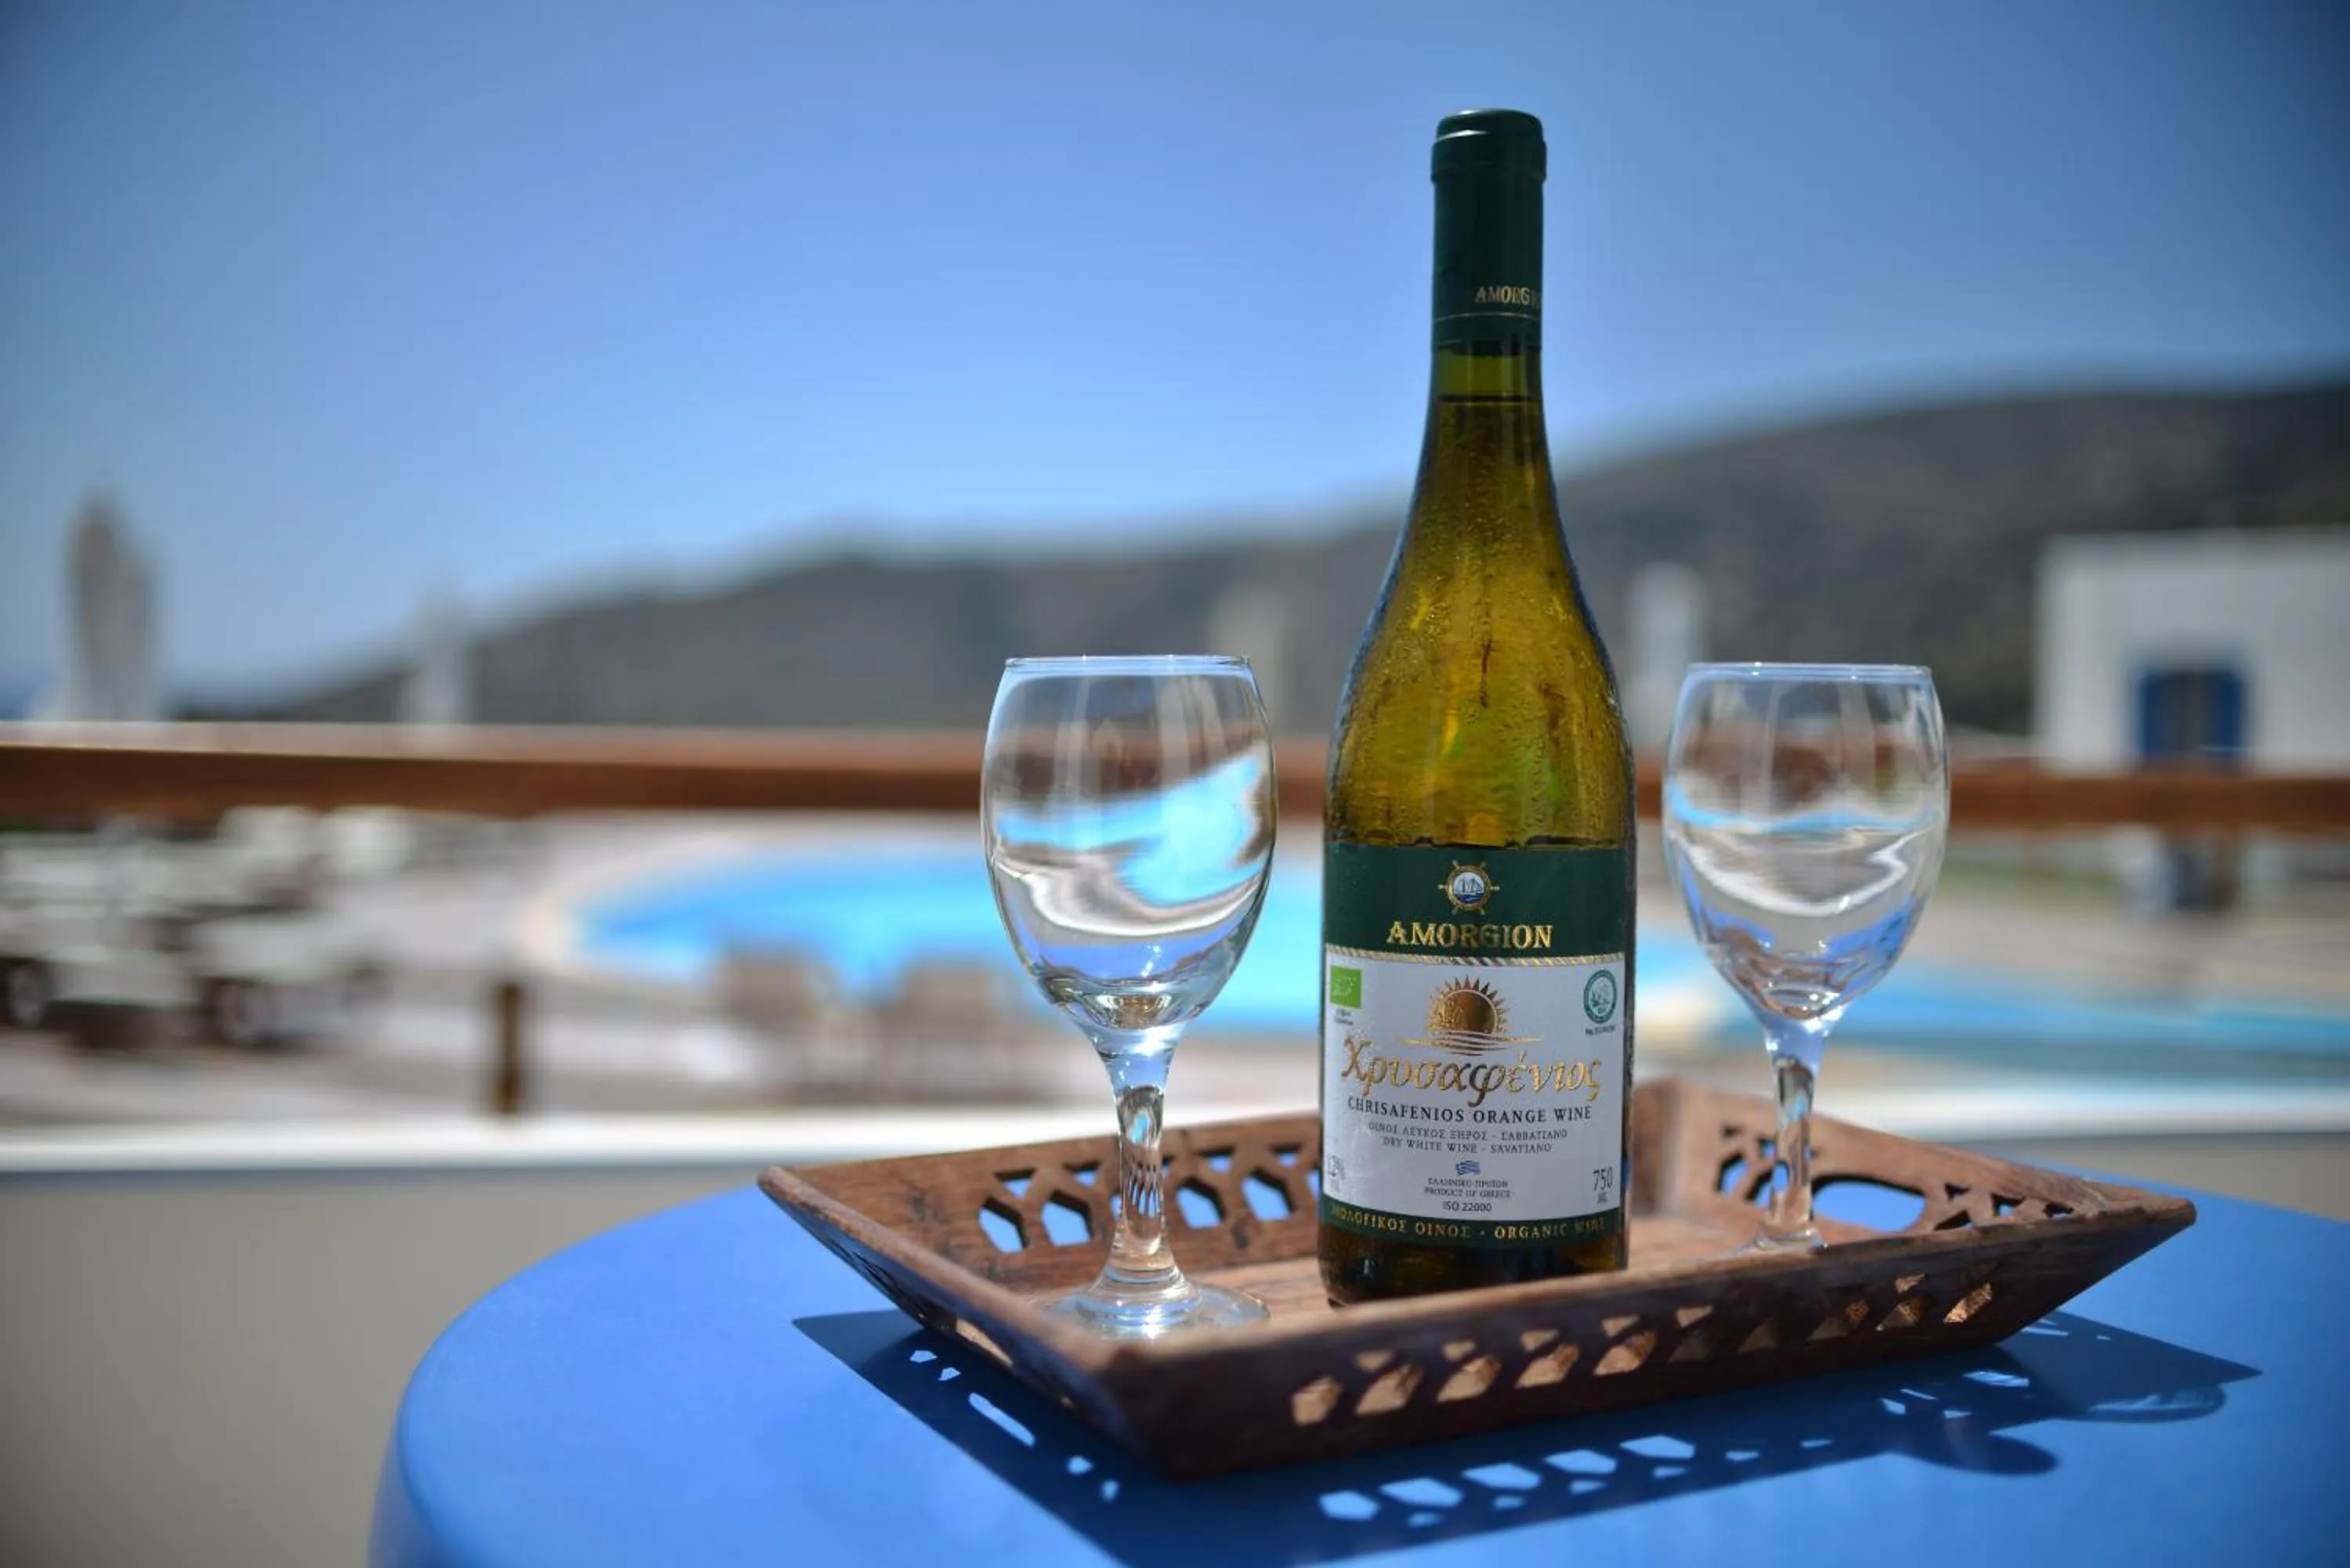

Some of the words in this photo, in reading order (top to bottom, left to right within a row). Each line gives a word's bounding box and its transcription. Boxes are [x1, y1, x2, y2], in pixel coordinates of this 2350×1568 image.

[1386, 921, 1553, 950] AMORGION
[1341, 1036, 1602, 1107] Χρυσαφένιος
[1347, 1096, 1465, 1123] CHRISAFENIOS
[1473, 1108, 1547, 1123] ORANGE
[1554, 1105, 1593, 1121] WINE
[1368, 1122, 1398, 1134] ΟΙΝΟΣ
[1402, 1126, 1445, 1139] ΛΕΥΚΟΣ
[1449, 1129, 1488, 1140] ΞΗΡΟΣ
[1383, 1136, 1403, 1147] DRY
[1406, 1140, 1443, 1151] WHITE
[1447, 1142, 1477, 1153] WINE
[1491, 1143, 1552, 1154] SAVATIANO
[1593, 1165, 1613, 1191] 750
[1424, 1187, 1463, 1198] PRODUCT
[1479, 1189, 1511, 1198] GREECE
[1442, 1201, 1459, 1212] ISO
[1462, 1202, 1492, 1212] 22000
[1415, 1221, 1470, 1239] ΟΙΝΟΣ
[1494, 1223, 1567, 1240] ORGANIC
[1574, 1216, 1606, 1234] WINE
